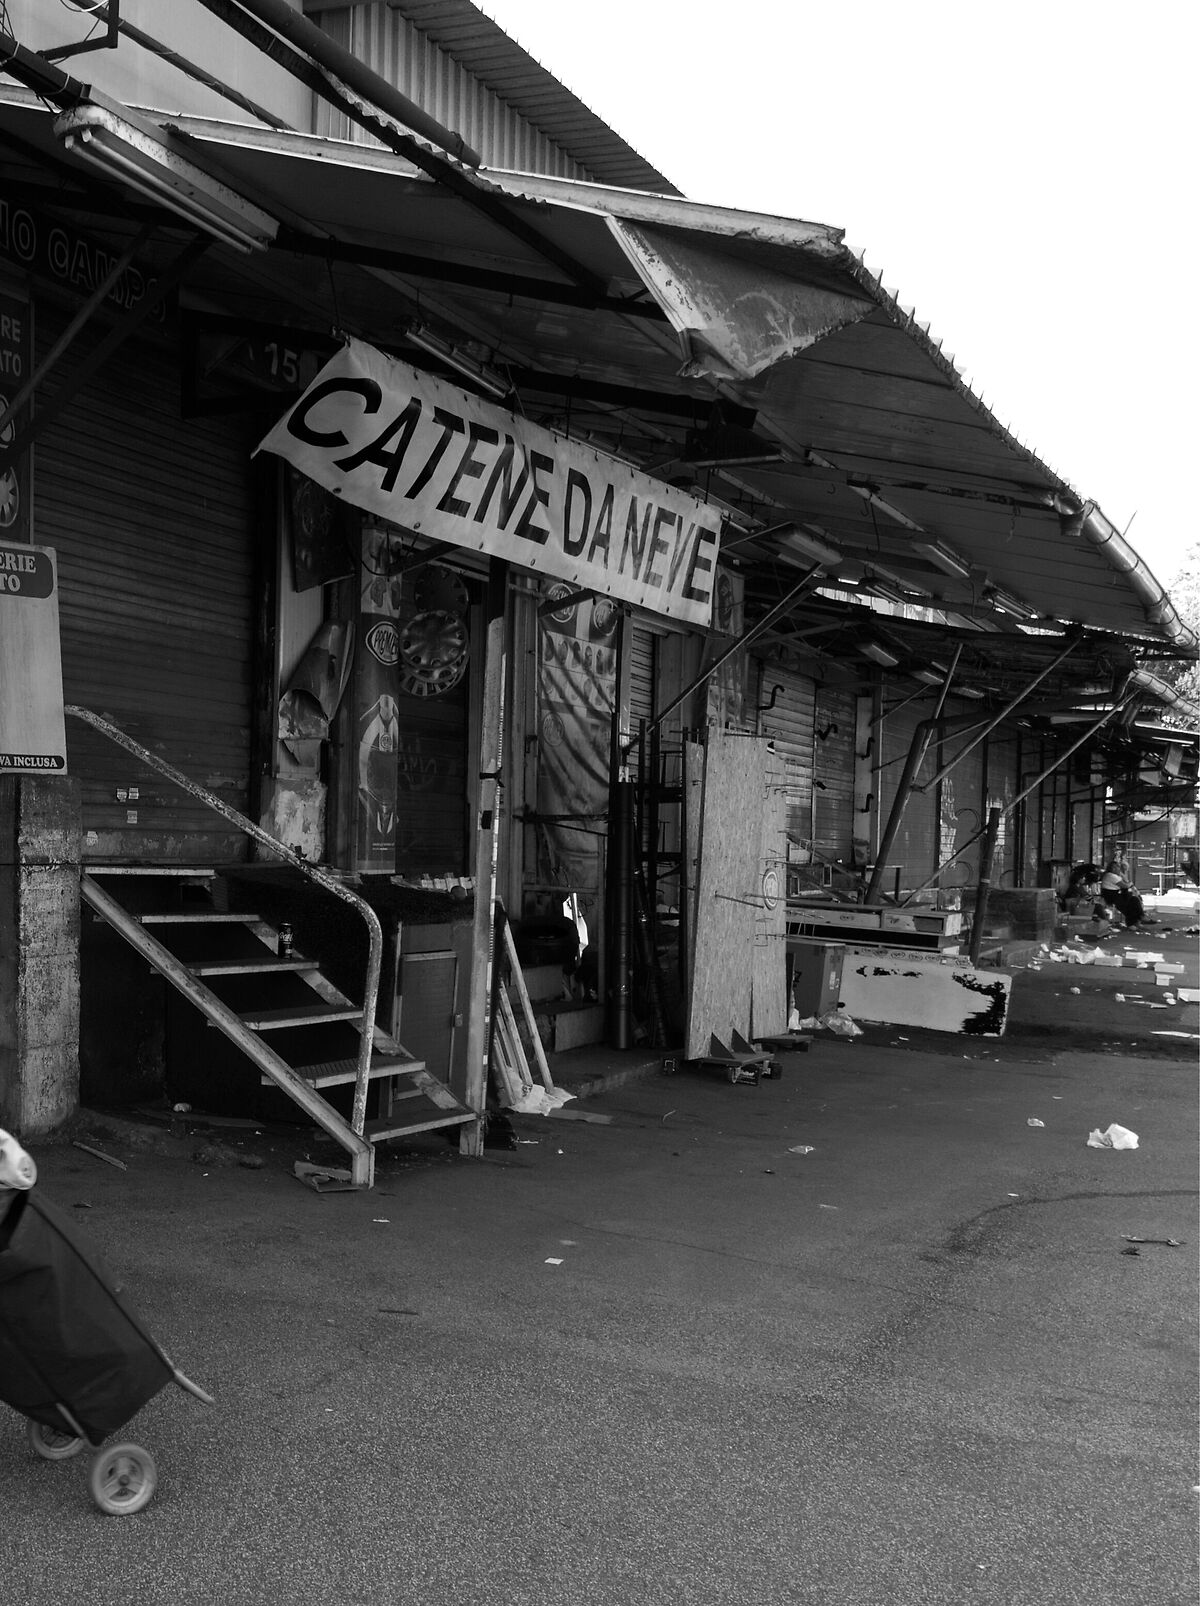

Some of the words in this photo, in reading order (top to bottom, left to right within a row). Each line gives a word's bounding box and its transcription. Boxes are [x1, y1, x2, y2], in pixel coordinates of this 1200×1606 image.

[287, 377, 556, 545] CATENE
[562, 467, 615, 569] DA
[618, 495, 717, 604] NEVE
[13, 756, 58, 768] INCLUSA
